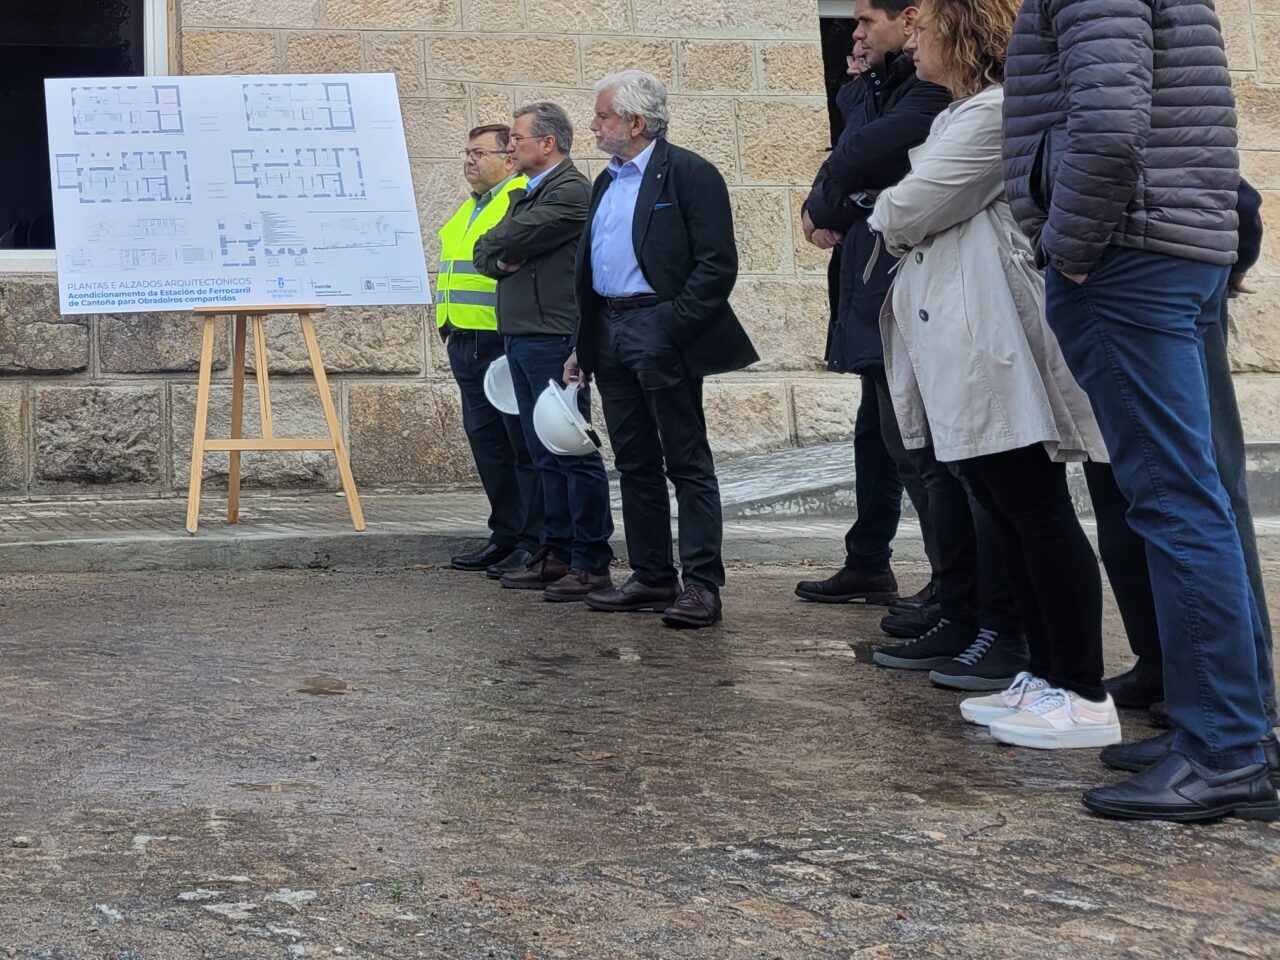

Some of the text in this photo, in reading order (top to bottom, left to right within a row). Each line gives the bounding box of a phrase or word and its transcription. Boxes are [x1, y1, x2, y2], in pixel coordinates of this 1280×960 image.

[67, 281, 109, 290] PLANTAS
[111, 281, 117, 289] E
[119, 280, 163, 289] ALZADOS
[68, 290, 146, 300] Acondicionamento
[147, 289, 158, 297] da
[160, 288, 195, 296] Estación
[209, 286, 251, 295] Ferrocarril
[68, 294, 237, 307] de Cantoña para Obradoiros compartidos
